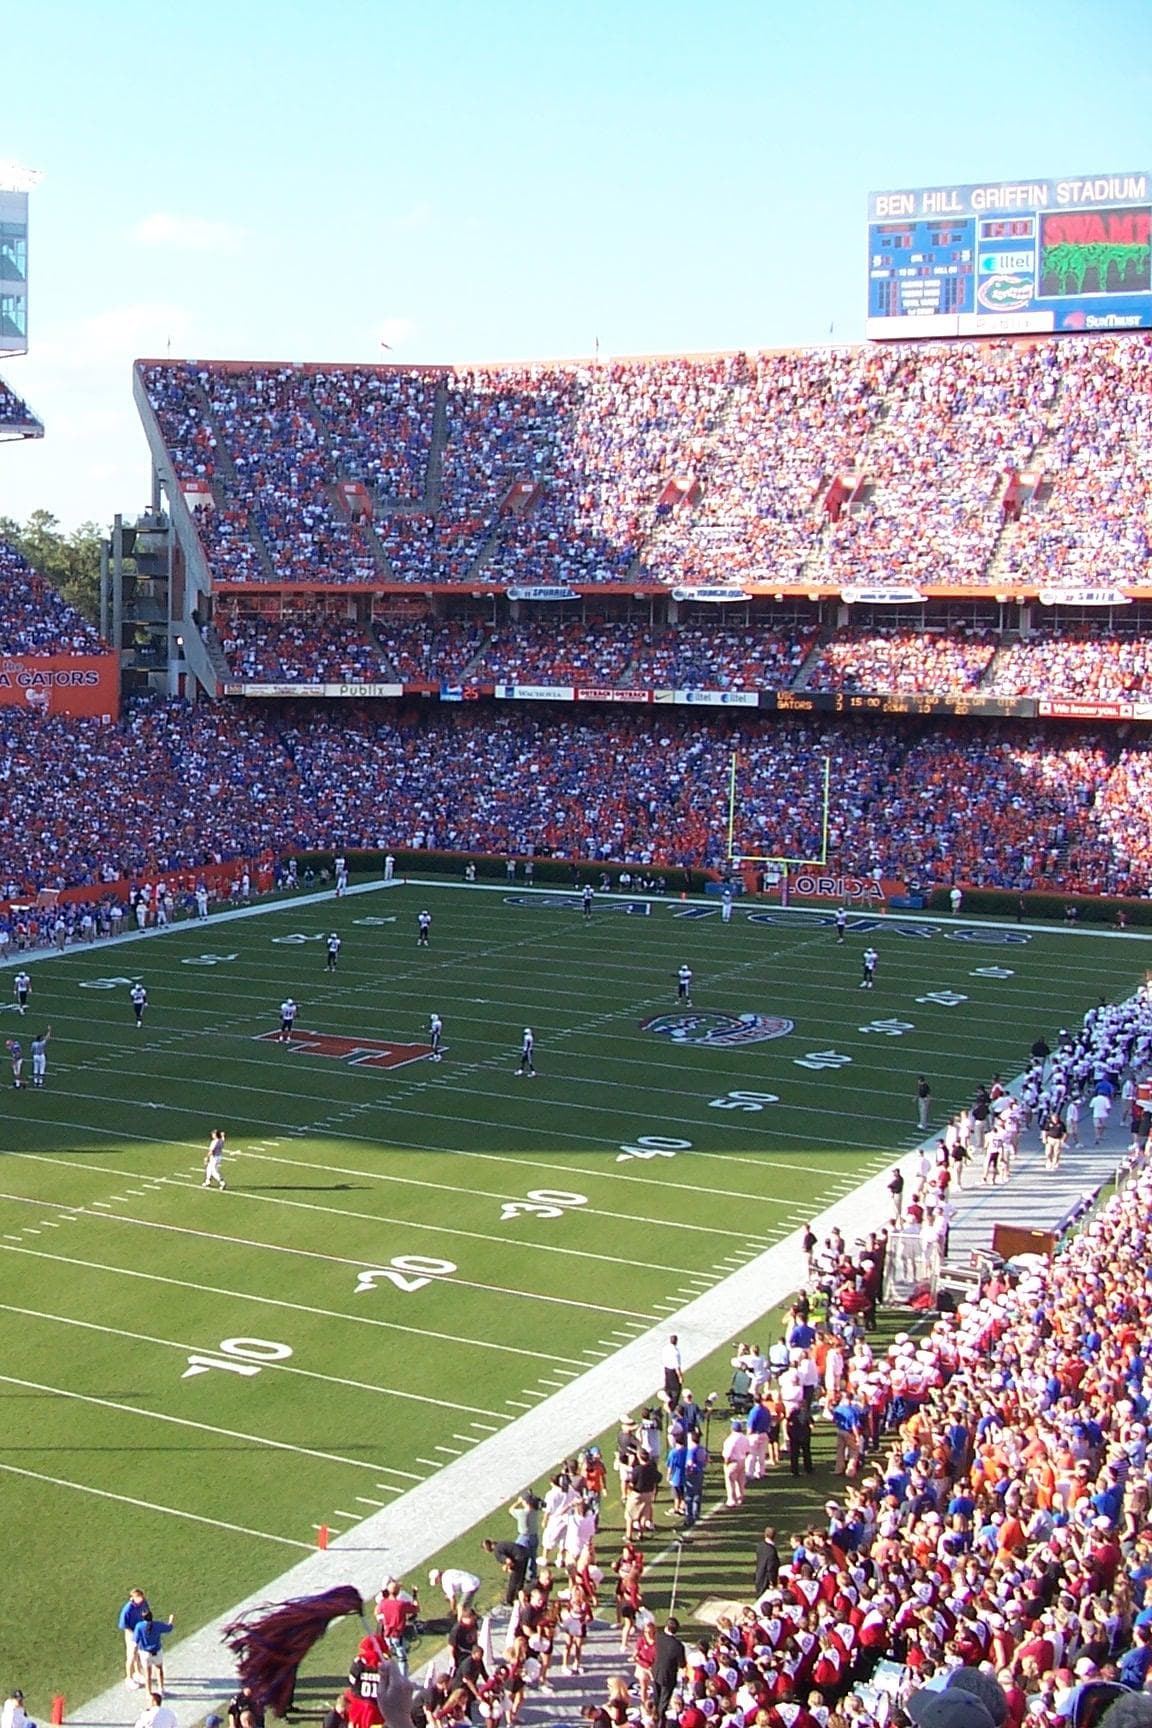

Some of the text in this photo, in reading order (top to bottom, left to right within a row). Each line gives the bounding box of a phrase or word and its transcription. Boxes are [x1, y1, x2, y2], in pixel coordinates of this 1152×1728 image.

[876, 177, 1146, 216] BEN HILL GRIFFIN STADIUM
[17, 671, 99, 687] GATORS
[340, 685, 384, 696] Publix
[464, 687, 478, 699] 25
[796, 1050, 852, 1070] 40
[710, 1091, 780, 1112] 50
[624, 1136, 692, 1160] 40
[501, 1189, 588, 1218] 30
[358, 1255, 458, 1293] 20
[188, 1337, 293, 1376] 10
[361, 1681, 378, 1697] 01
